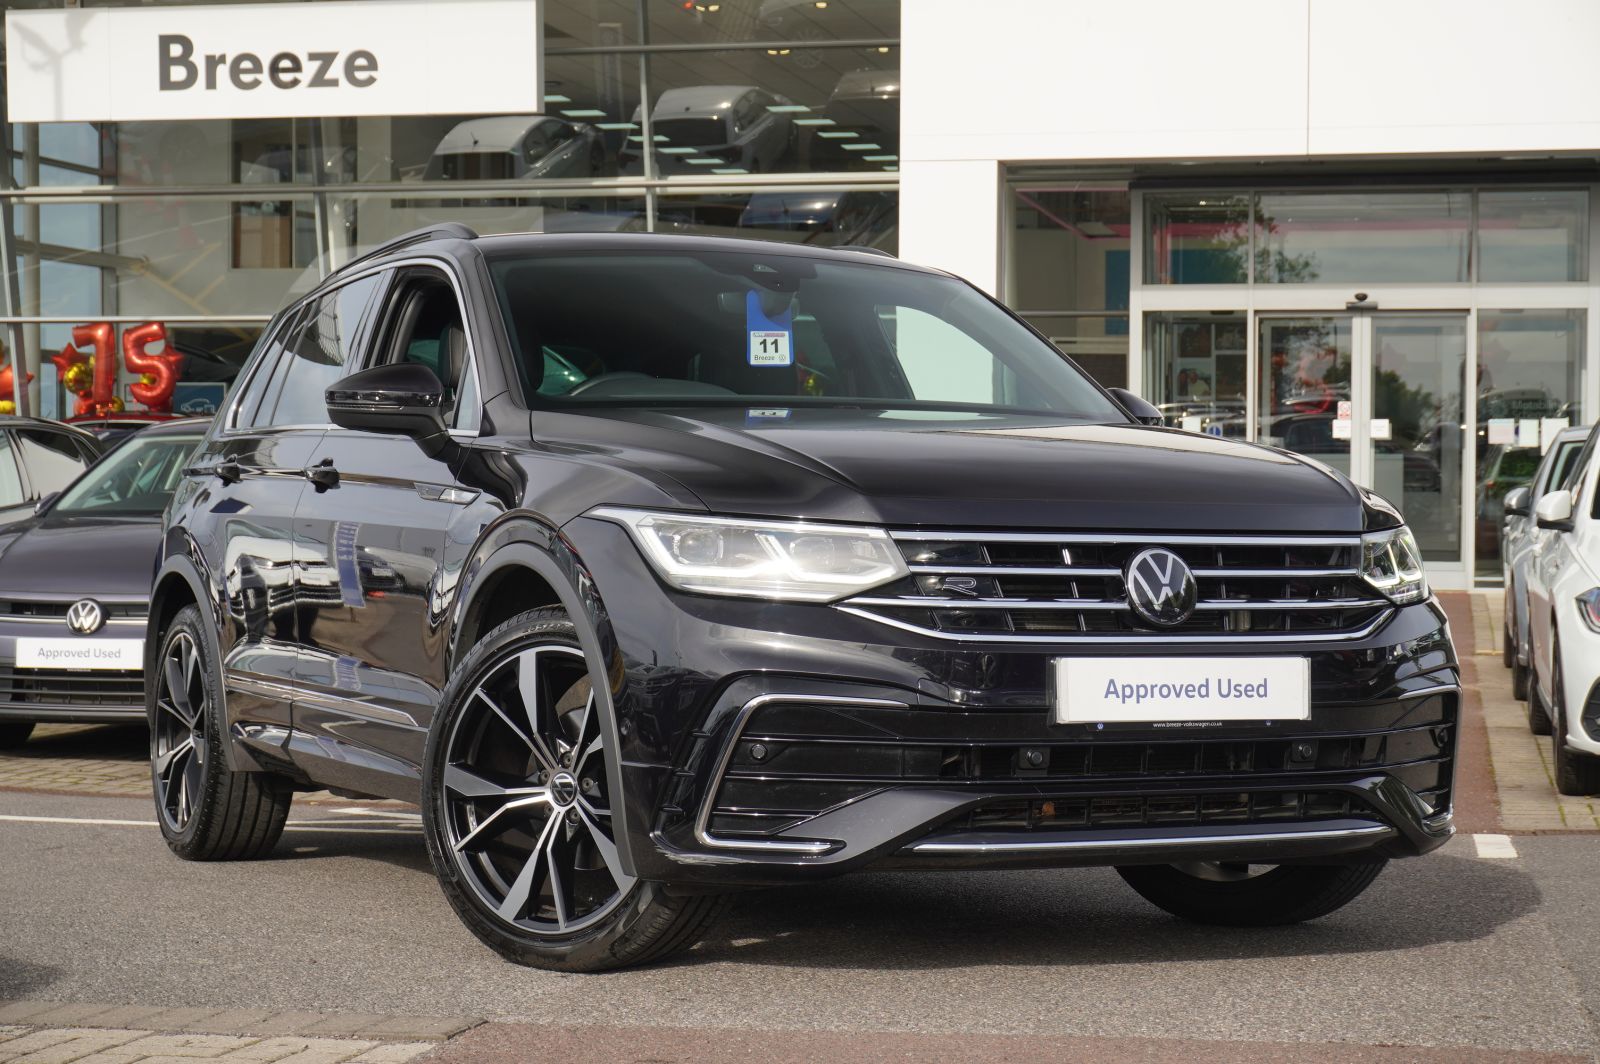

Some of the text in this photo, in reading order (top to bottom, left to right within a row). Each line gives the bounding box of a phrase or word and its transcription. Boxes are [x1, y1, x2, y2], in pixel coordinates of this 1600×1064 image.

[158, 33, 379, 91] Breeze
[759, 338, 779, 353] 11
[37, 647, 121, 660] Approved Used
[1104, 677, 1269, 704] Approved Used
[1152, 721, 1223, 729] www.breeze-volkswagen.co.uk
